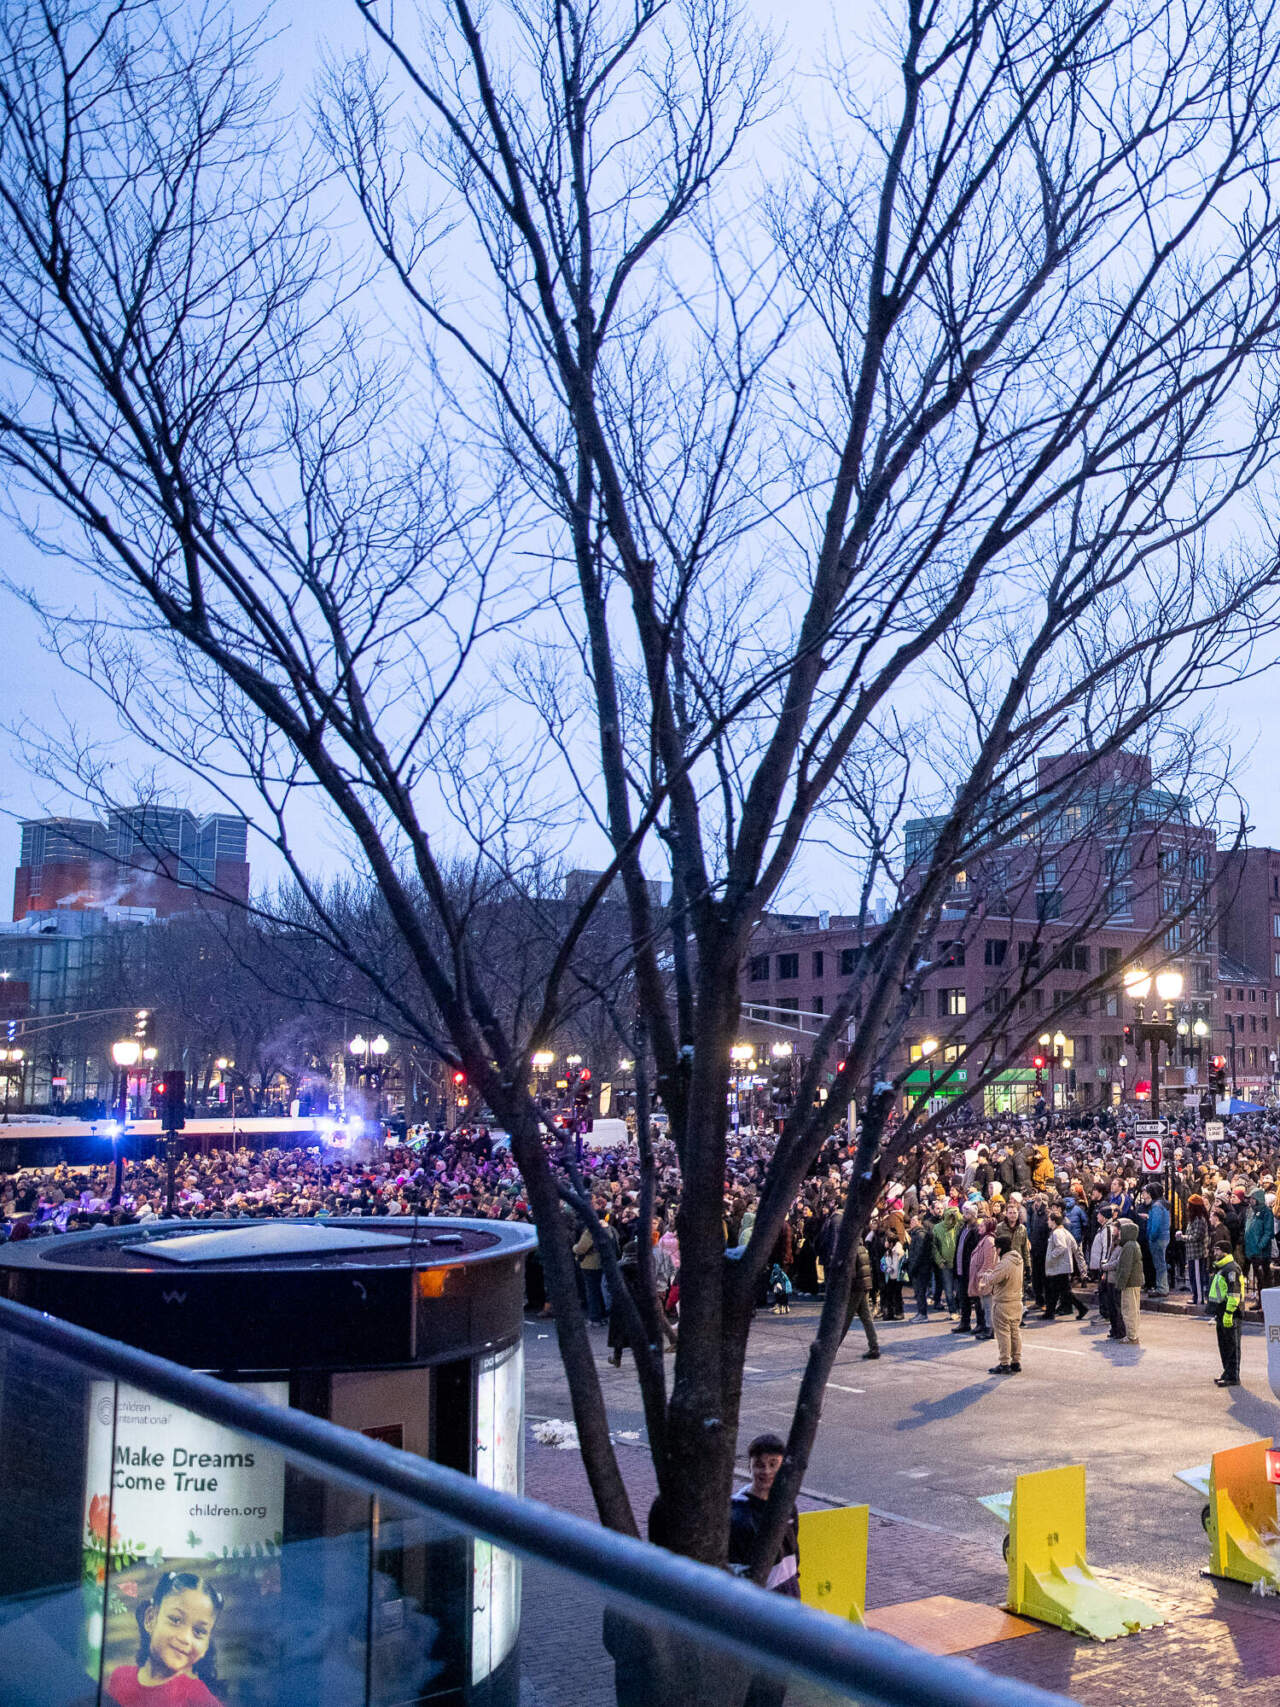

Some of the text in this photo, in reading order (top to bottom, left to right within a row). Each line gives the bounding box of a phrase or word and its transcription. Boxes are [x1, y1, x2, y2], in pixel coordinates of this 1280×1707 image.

[116, 1446, 255, 1467] Make Dreams
[114, 1470, 218, 1492] Come True
[188, 1504, 267, 1518] children.org
